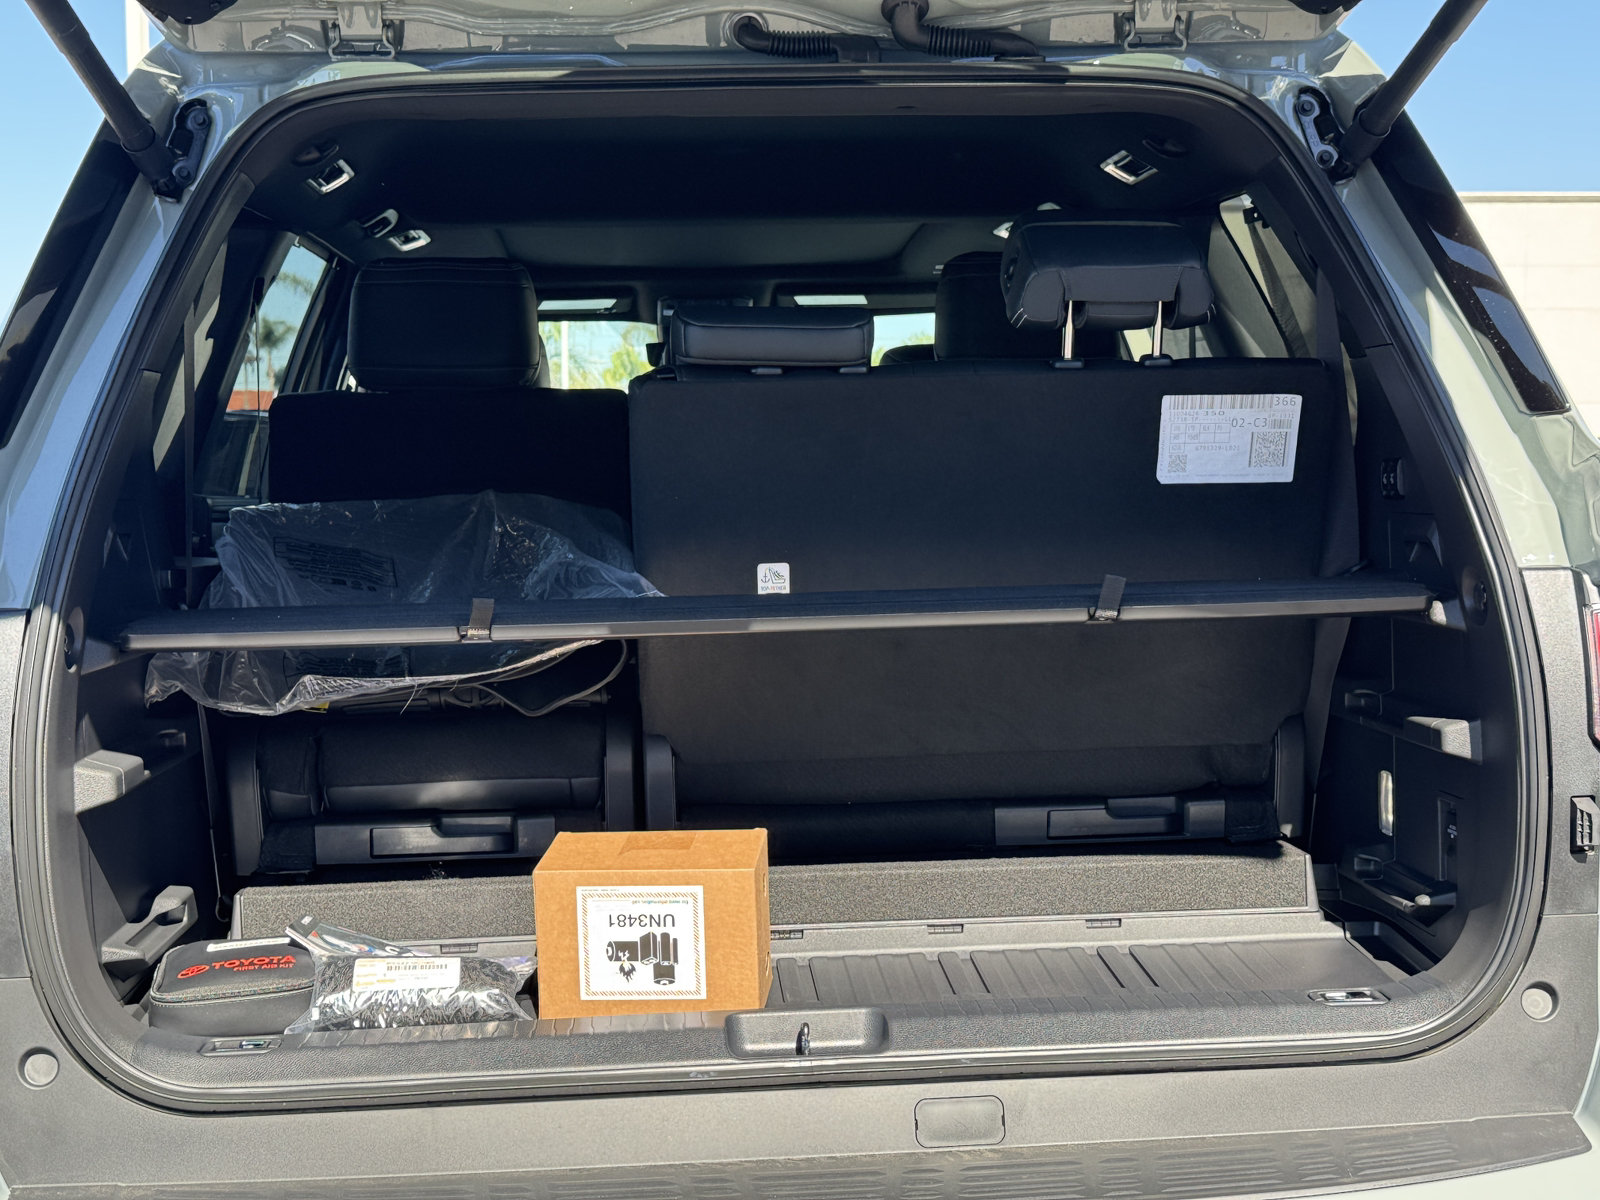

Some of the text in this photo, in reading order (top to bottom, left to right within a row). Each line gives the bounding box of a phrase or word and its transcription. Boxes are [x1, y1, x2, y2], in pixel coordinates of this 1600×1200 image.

[1274, 396, 1297, 407] 366
[1231, 417, 1268, 428] 02-C3
[608, 913, 676, 928] UN3481
[211, 955, 297, 970] TOYOTA
